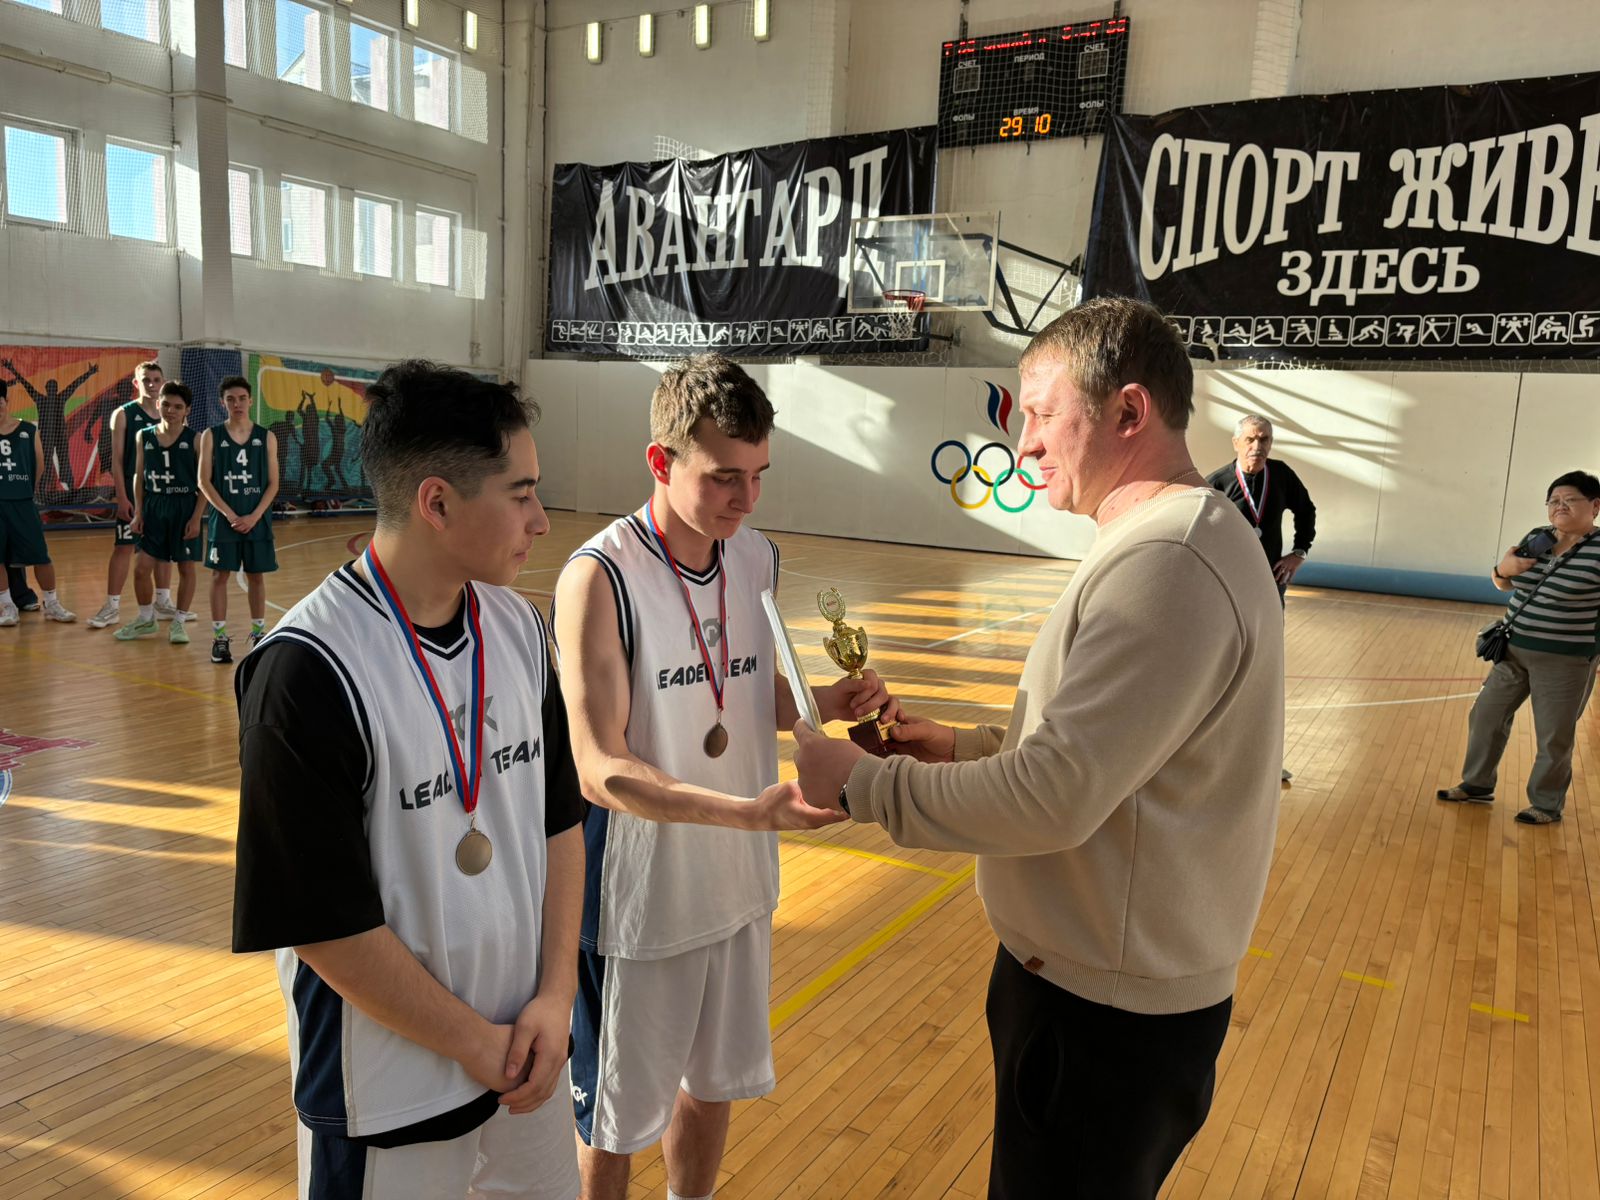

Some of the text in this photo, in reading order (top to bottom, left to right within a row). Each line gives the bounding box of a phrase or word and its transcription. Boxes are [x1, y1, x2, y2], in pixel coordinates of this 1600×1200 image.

[1014, 53, 1045, 63] ПЕРИОД
[1079, 100, 1104, 110] ФОЛЫ
[952, 113, 975, 122] ФОЛЫ
[1139, 132, 1361, 281] СПОРТ
[584, 145, 888, 299] АВАНГАРД
[1276, 247, 1481, 308] ЗДЕСЬ
[162, 450, 171, 467] 1
[236, 449, 248, 466] 4
[166, 486, 189, 494] group
[117, 525, 133, 540] 12
[210, 547, 220, 564] 4
